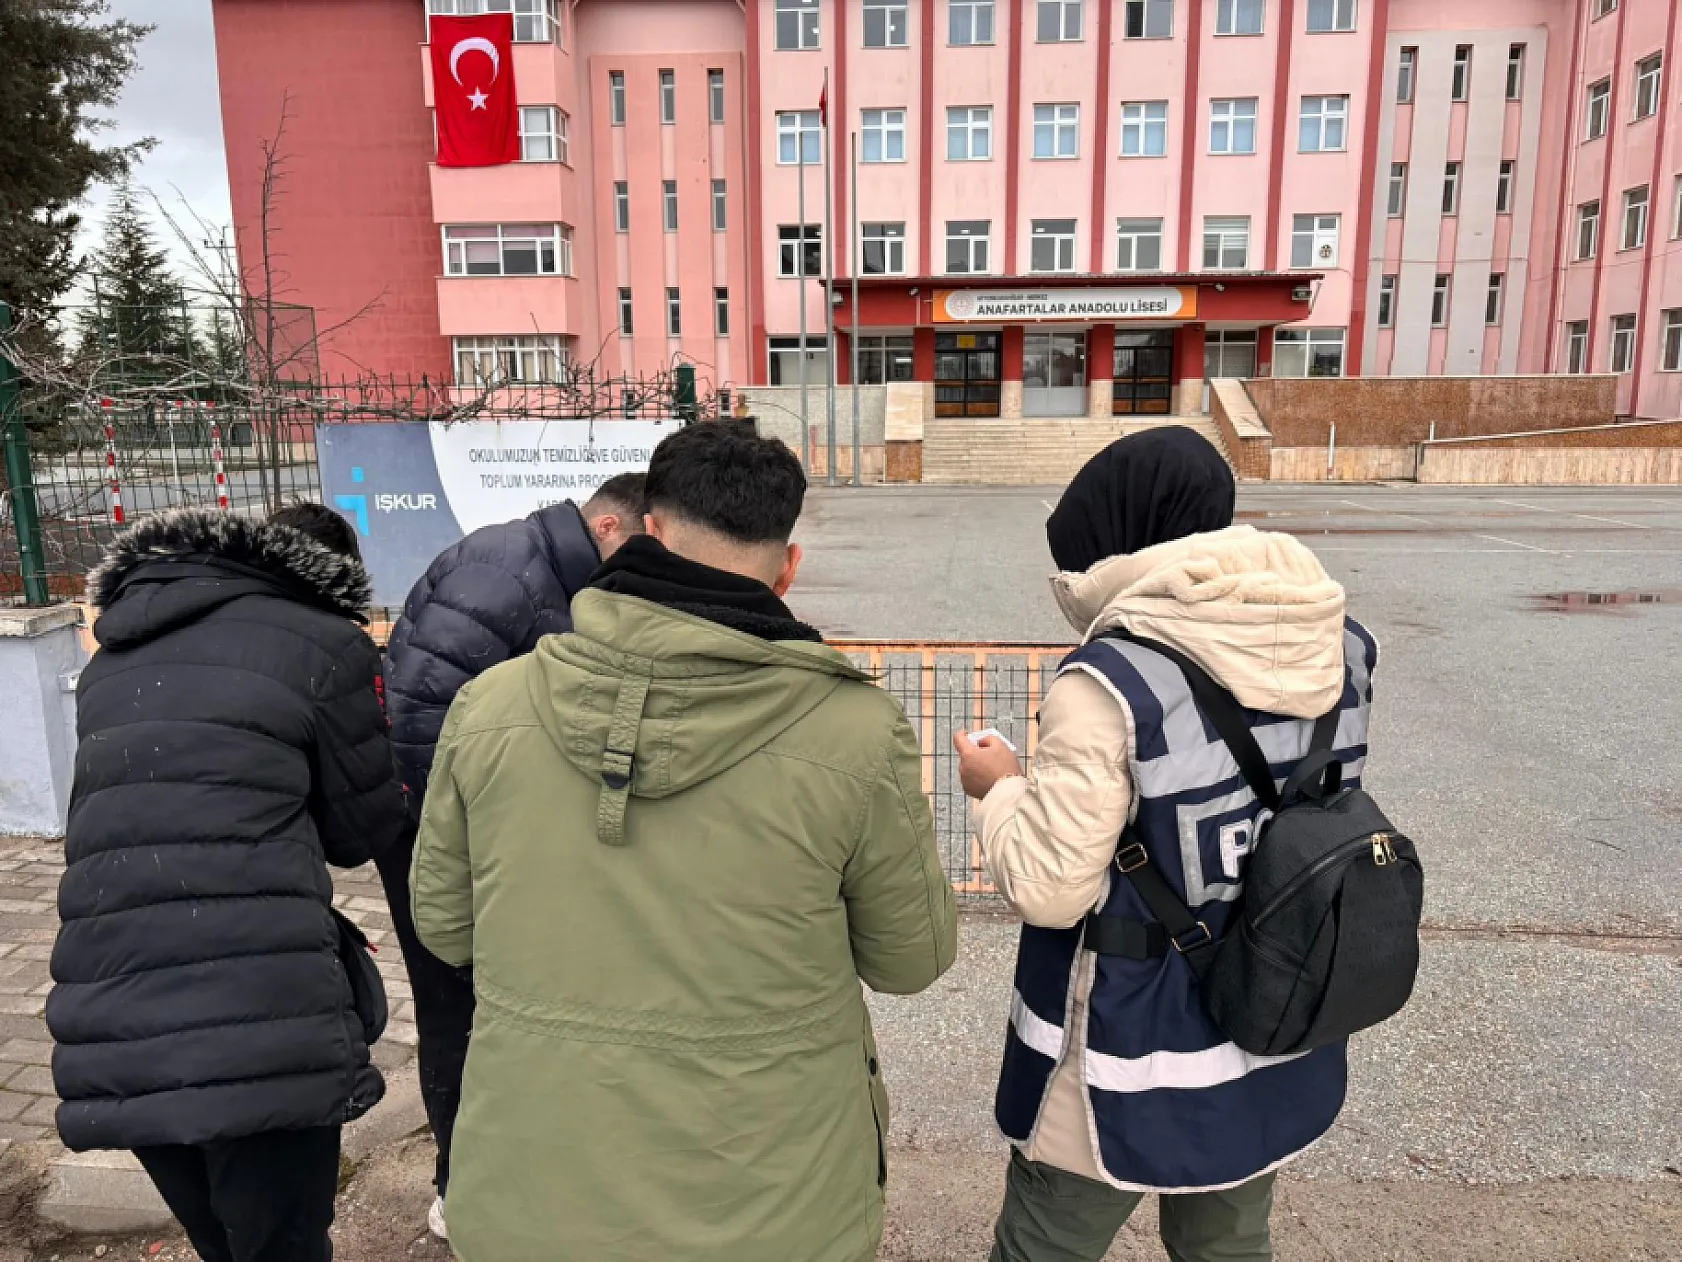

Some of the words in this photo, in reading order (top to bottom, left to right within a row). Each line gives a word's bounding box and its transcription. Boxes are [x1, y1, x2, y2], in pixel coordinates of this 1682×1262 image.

[977, 302, 1066, 316] ANAFARTALAR
[1069, 301, 1129, 314] ANADOLU
[1130, 297, 1168, 313] LİSESİ
[469, 448, 541, 463] OKULUMUZUN
[595, 448, 610, 463] VE
[611, 444, 652, 463] GÜVENL
[480, 474, 521, 488] TOPLUM
[523, 474, 576, 488] YARARINA
[577, 474, 614, 488] PROG
